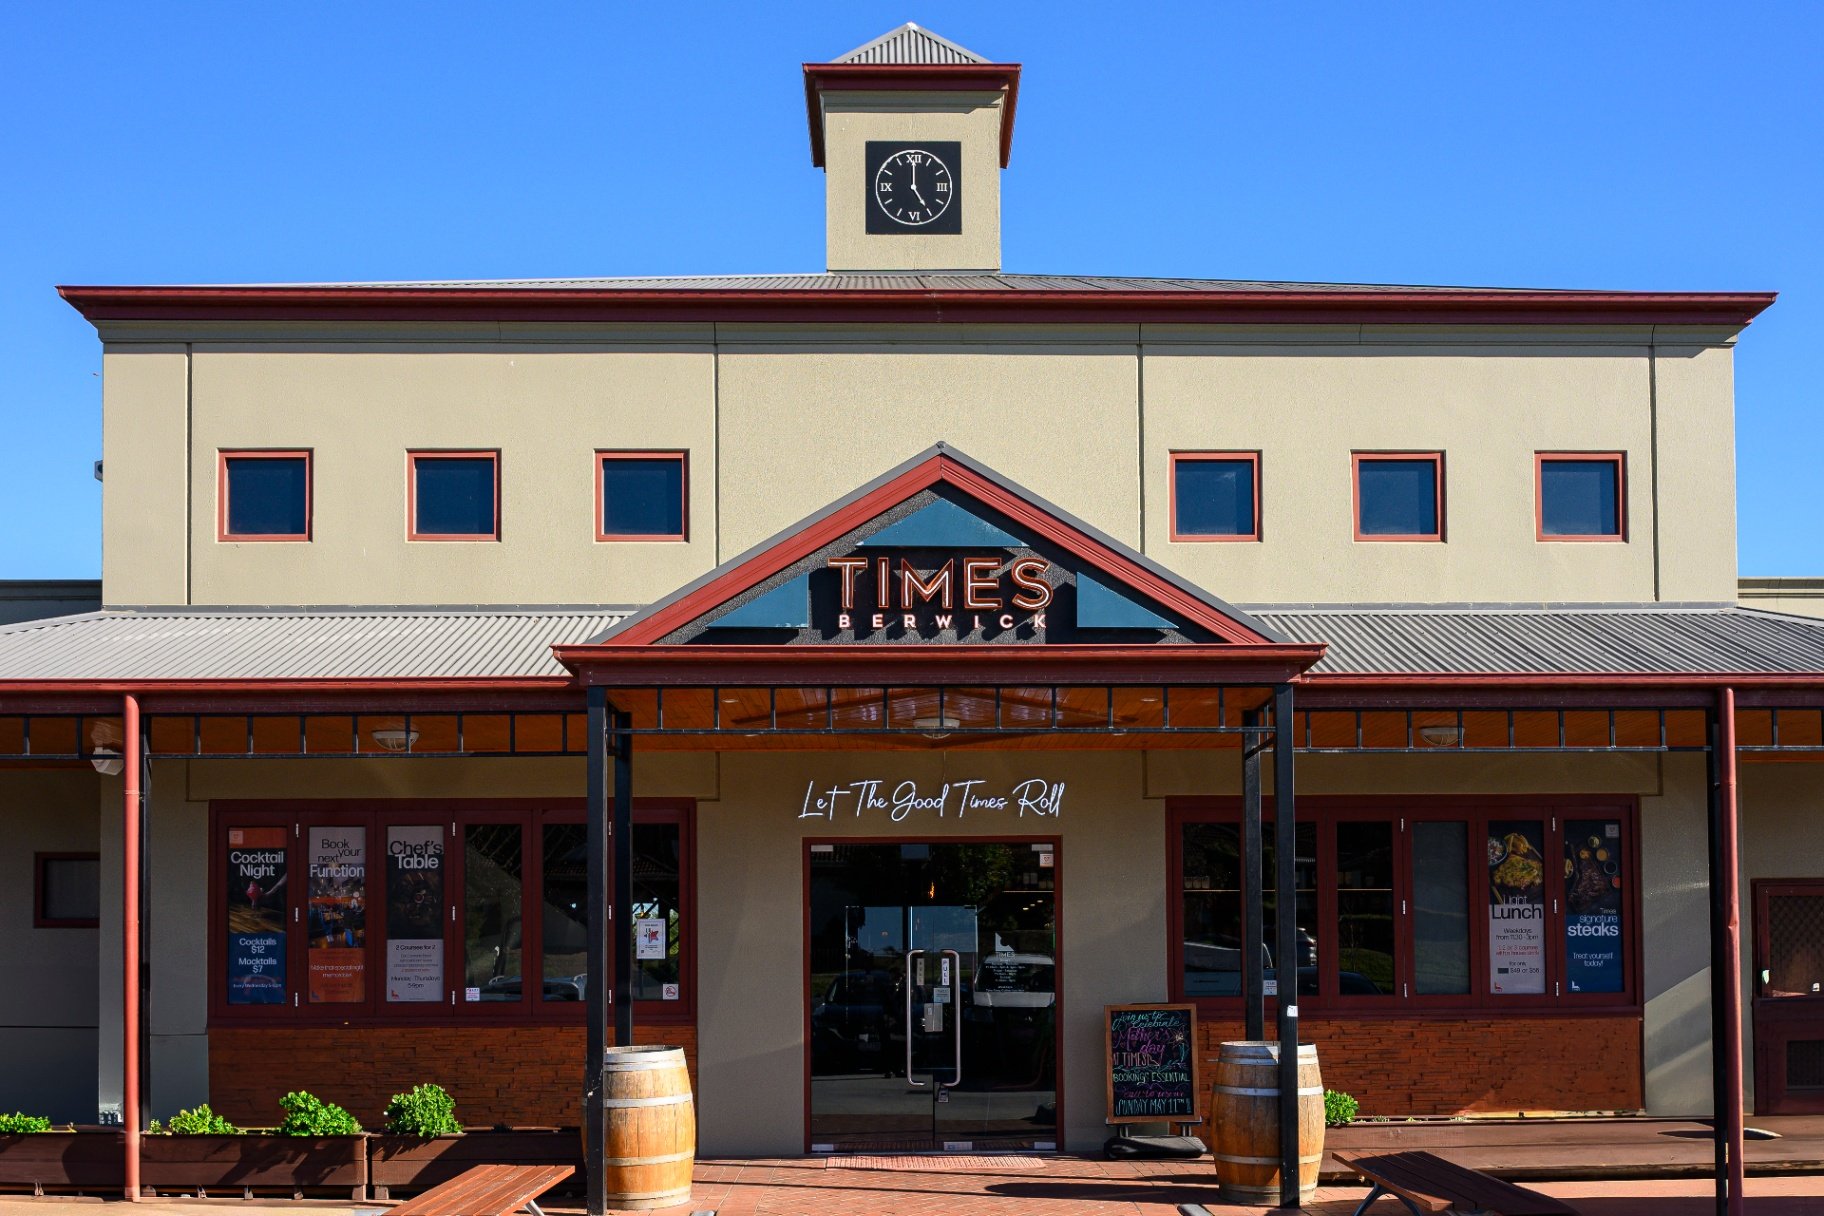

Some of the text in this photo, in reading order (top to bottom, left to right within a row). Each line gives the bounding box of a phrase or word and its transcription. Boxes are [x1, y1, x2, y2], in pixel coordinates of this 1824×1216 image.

[906, 154, 922, 164] XII
[880, 182, 893, 192] IX
[936, 182, 948, 192] III
[908, 211, 920, 221] VI
[828, 557, 1054, 611] TIMES
[838, 614, 1047, 630] BERWICK
[798, 778, 1065, 822] Let The Good Times Roll
[321, 838, 350, 849] Book
[390, 840, 443, 855] Chef's
[230, 851, 284, 864] Cocktail
[317, 853, 339, 863] next
[338, 848, 362, 858] your
[394, 854, 439, 869] Table
[240, 864, 276, 879] Night
[309, 864, 365, 879] Function
[1492, 904, 1542, 920] Lunch
[1579, 914, 1618, 924] signature
[1567, 922, 1619, 937] steaks
[238, 938, 277, 946] Cocktails
[251, 945, 265, 954] $12
[238, 957, 277, 966] Mocktails
[252, 965, 263, 974] $7
